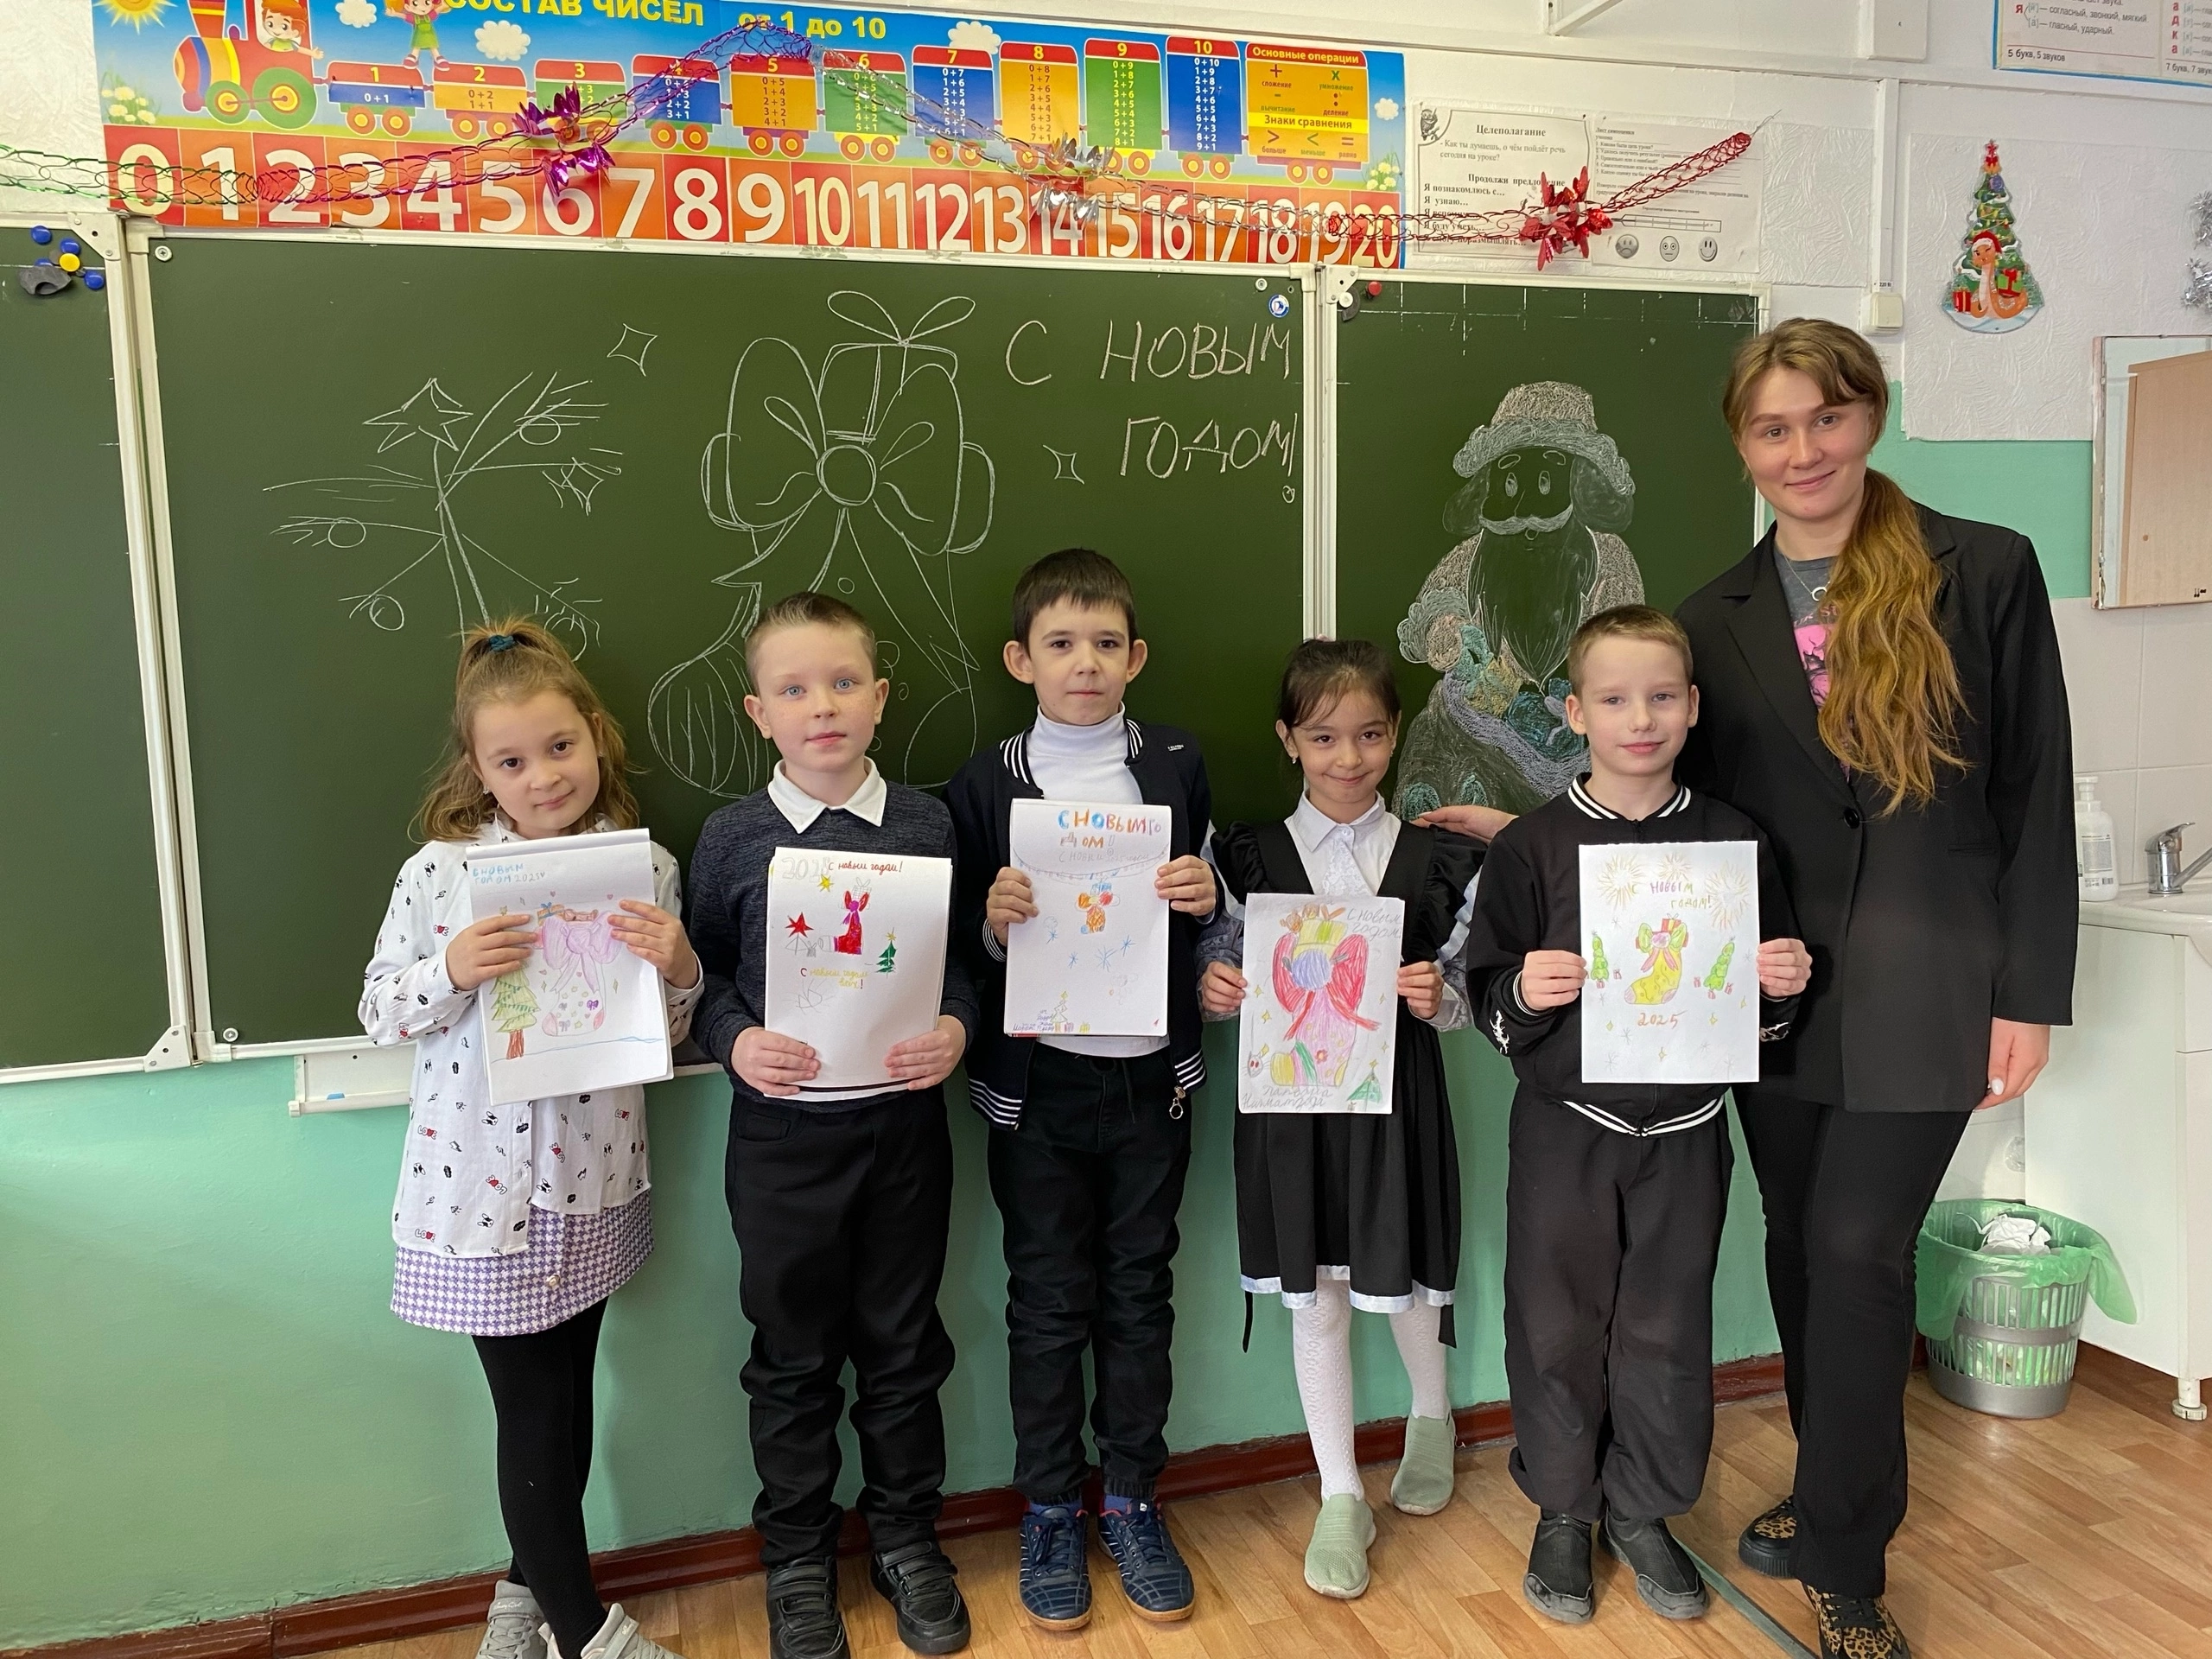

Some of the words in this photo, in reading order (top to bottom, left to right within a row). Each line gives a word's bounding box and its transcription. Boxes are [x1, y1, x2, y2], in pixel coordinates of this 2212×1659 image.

[593, 0, 703, 26] ЧИСЕЛ
[739, 14, 771, 30] от
[781, 11, 793, 33] 1
[806, 18, 842, 39] до
[853, 16, 887, 39] 10
[1033, 46, 1044, 60] 8
[1117, 43, 1128, 56] 9
[1194, 41, 1212, 54] 10
[859, 54, 870, 69] 6
[947, 50, 957, 64] 7
[1253, 47, 1306, 60] Основные
[1308, 53, 1359, 64] операции
[574, 63, 585, 79] 3
[767, 58, 778, 73] 5
[370, 67, 380, 82] 1
[474, 67, 486, 82] 2
[1264, 115, 1295, 125] Знаки
[1298, 118, 1352, 129] сравнения
[1477, 124, 1547, 137] Целеполагание
[1444, 139, 1458, 148] Как
[1469, 143, 1502, 152] думаешь,
[1549, 146, 1566, 155] речь
[1440, 152, 1466, 161] сегодня
[1468, 174, 1509, 185] Продолжи
[1512, 178, 1566, 188] предлоение
[1424, 183, 1430, 192] Я
[1433, 185, 1491, 195] познакомлюсь
[200, 147, 239, 221] 1
[264, 149, 321, 224] 2
[340, 152, 393, 228] 3
[405, 158, 462, 232] 4
[479, 160, 527, 234] 5
[542, 170, 594, 236] 6
[608, 168, 655, 238] 7
[672, 168, 722, 241] 8
[736, 172, 785, 244] 9
[793, 175, 851, 247] 10
[856, 181, 908, 250] 11
[914, 183, 971, 252] 12
[973, 185, 1027, 254] 13
[1030, 188, 1084, 257] 14
[1088, 192, 1139, 258] 15
[1142, 194, 1192, 260] 16
[1197, 198, 1245, 263] 17
[1251, 198, 1297, 264] 18
[1303, 200, 1348, 265] 19
[1351, 204, 1399, 268] 20
[1434, 198, 1468, 207] узнаю...
[1005, 320, 1052, 385] С
[1099, 319, 1290, 382] НОВЫМ
[1120, 412, 1298, 503] ГОДОМ!
[1637, 1009, 1688, 1029] 2025
